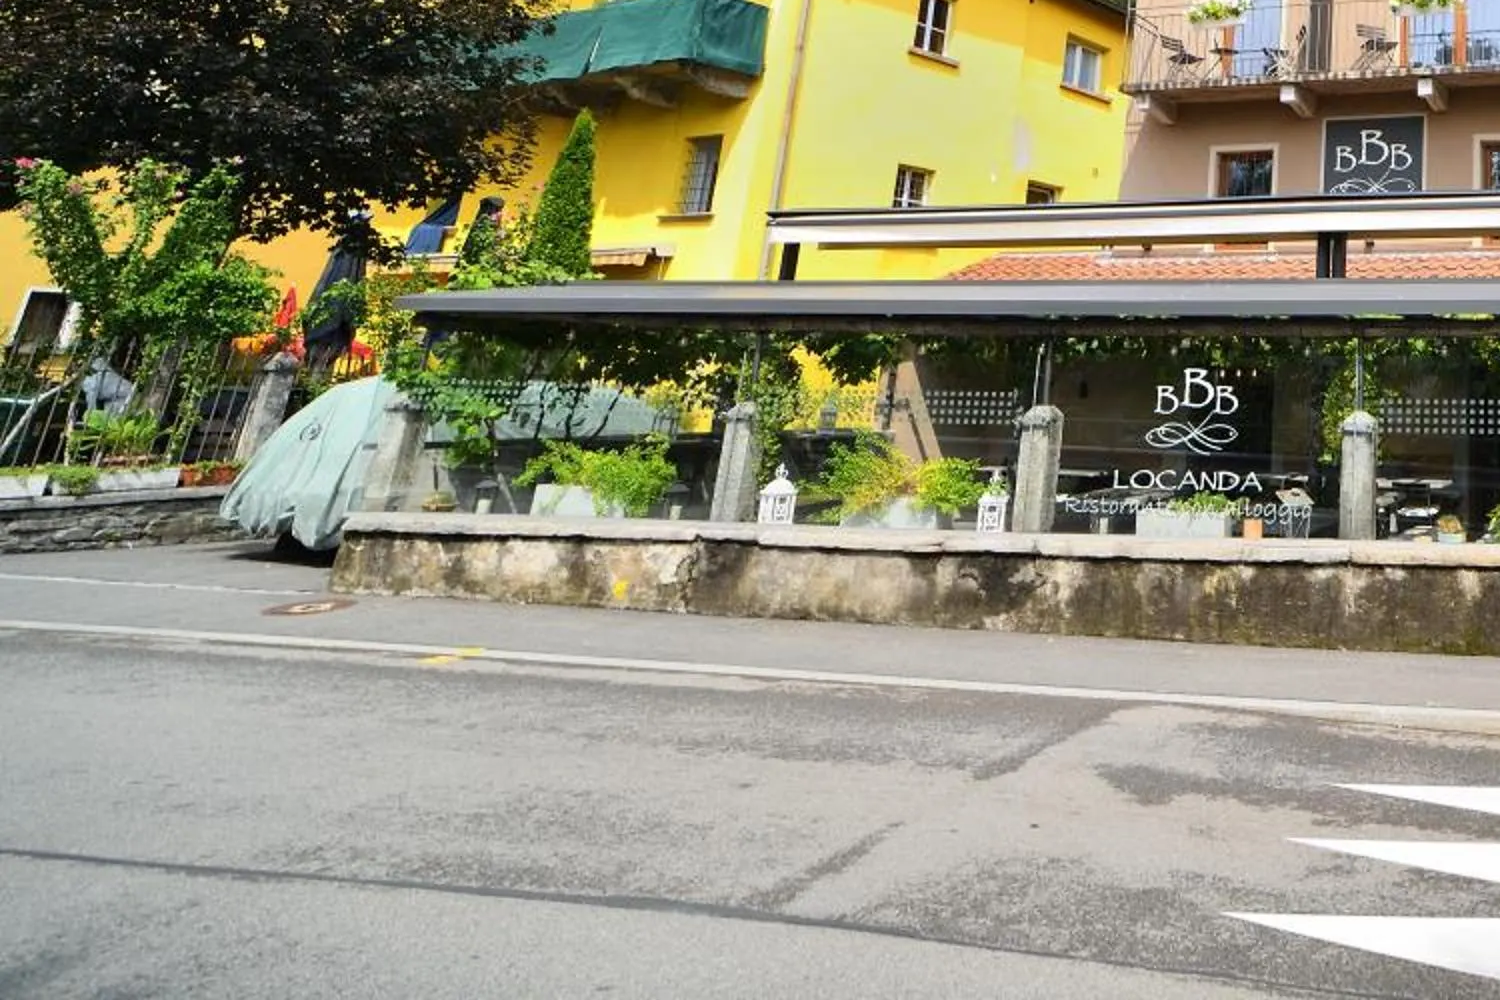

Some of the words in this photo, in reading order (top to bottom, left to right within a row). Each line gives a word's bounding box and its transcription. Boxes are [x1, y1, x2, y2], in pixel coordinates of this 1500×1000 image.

[1333, 129, 1413, 172] BBB
[1154, 367, 1239, 414] BBB
[1113, 469, 1262, 491] LOCANDA
